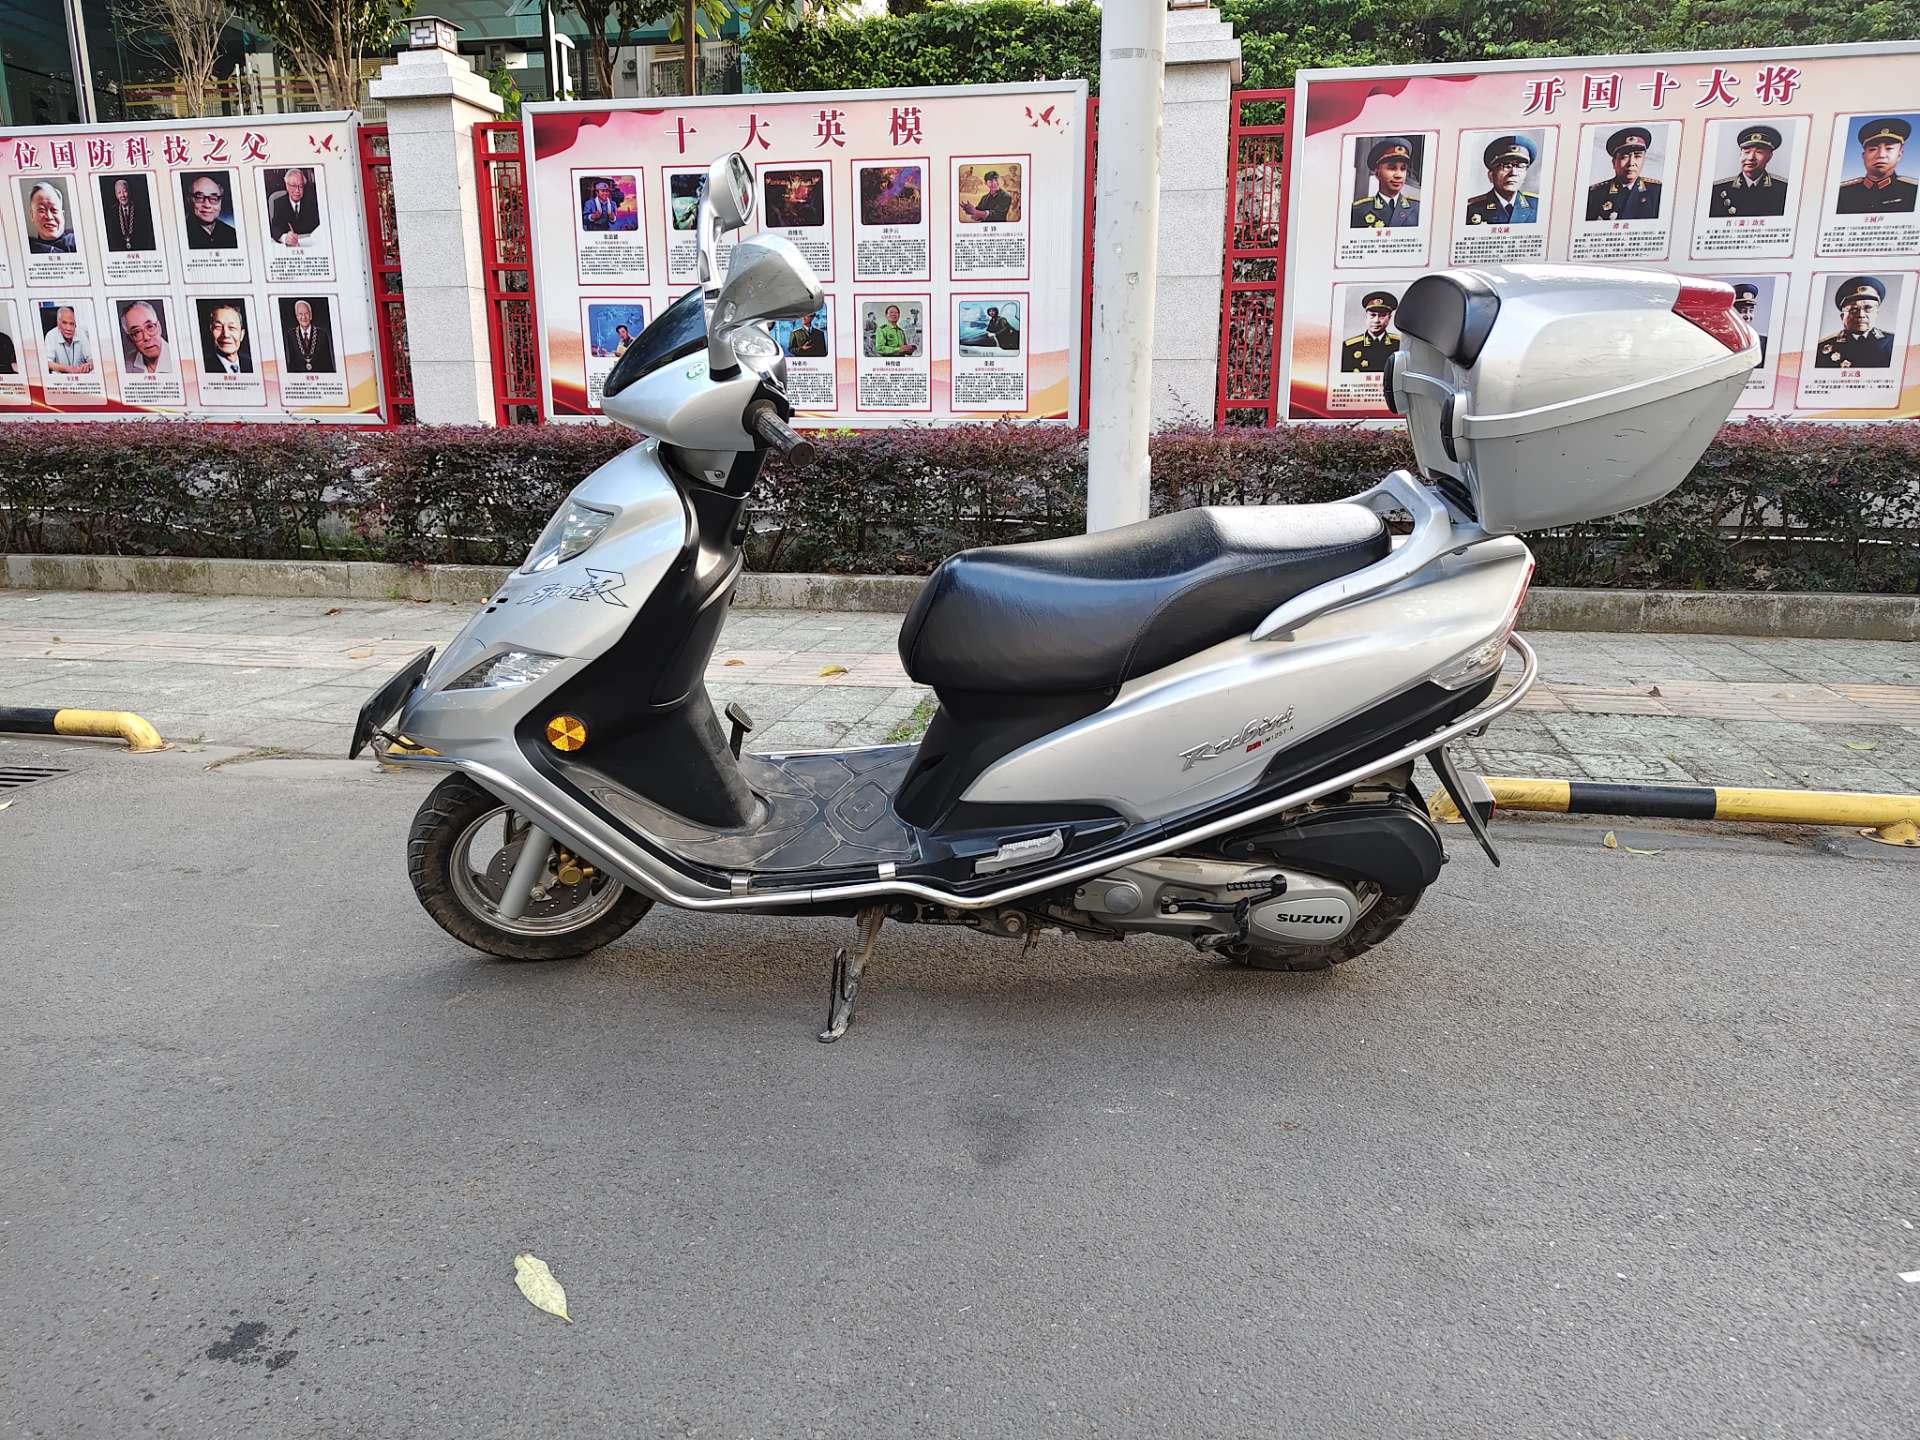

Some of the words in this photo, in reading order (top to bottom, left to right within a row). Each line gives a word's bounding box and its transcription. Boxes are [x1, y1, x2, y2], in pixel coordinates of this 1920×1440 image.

[1523, 67, 1800, 114] 开国十大将
[14, 131, 268, 170] 位国防科技之父
[664, 107, 923, 154] 十大英模
[1276, 913, 1344, 924] SUZUKI
